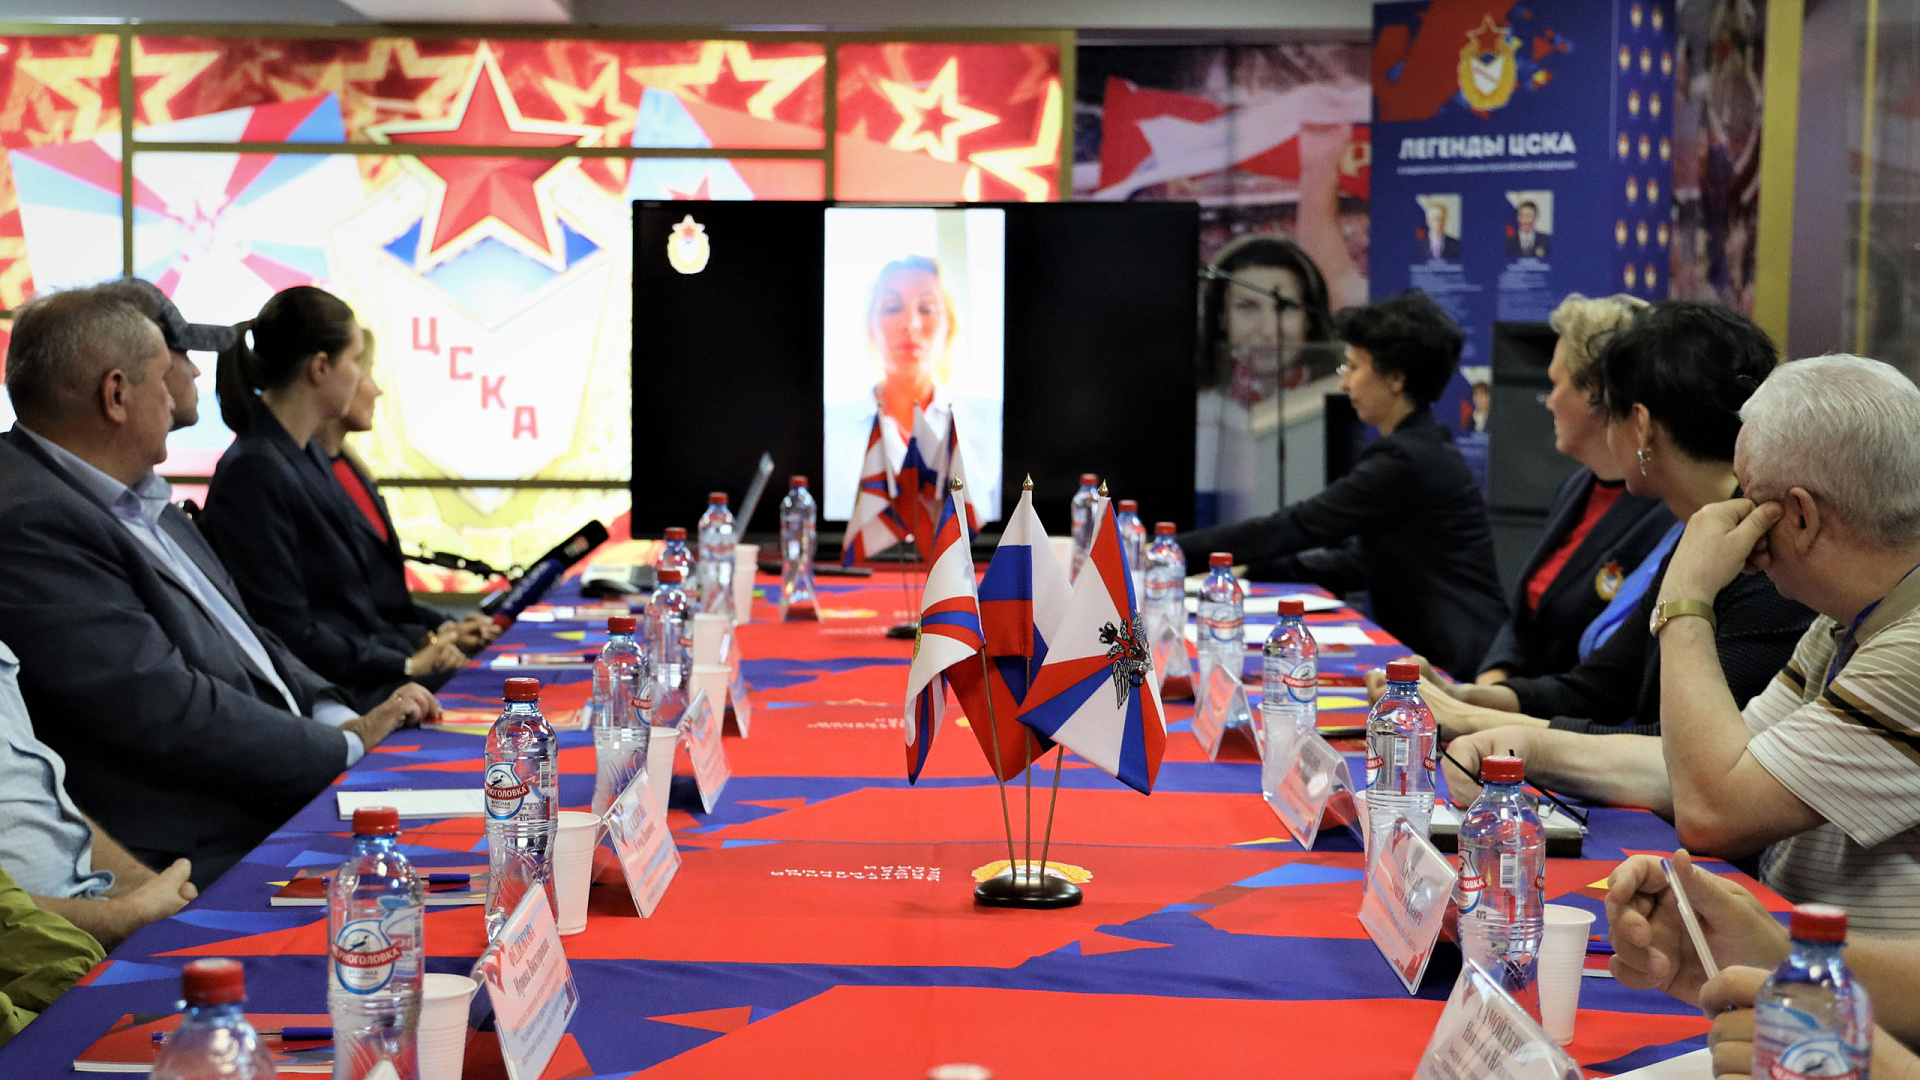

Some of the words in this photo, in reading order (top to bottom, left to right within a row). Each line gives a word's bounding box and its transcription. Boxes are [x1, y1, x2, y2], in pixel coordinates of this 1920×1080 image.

[1399, 135, 1505, 160] ЛЕГЕНДЫ
[1508, 131, 1577, 156] ЦСКА
[412, 316, 538, 439] ЦСКА
